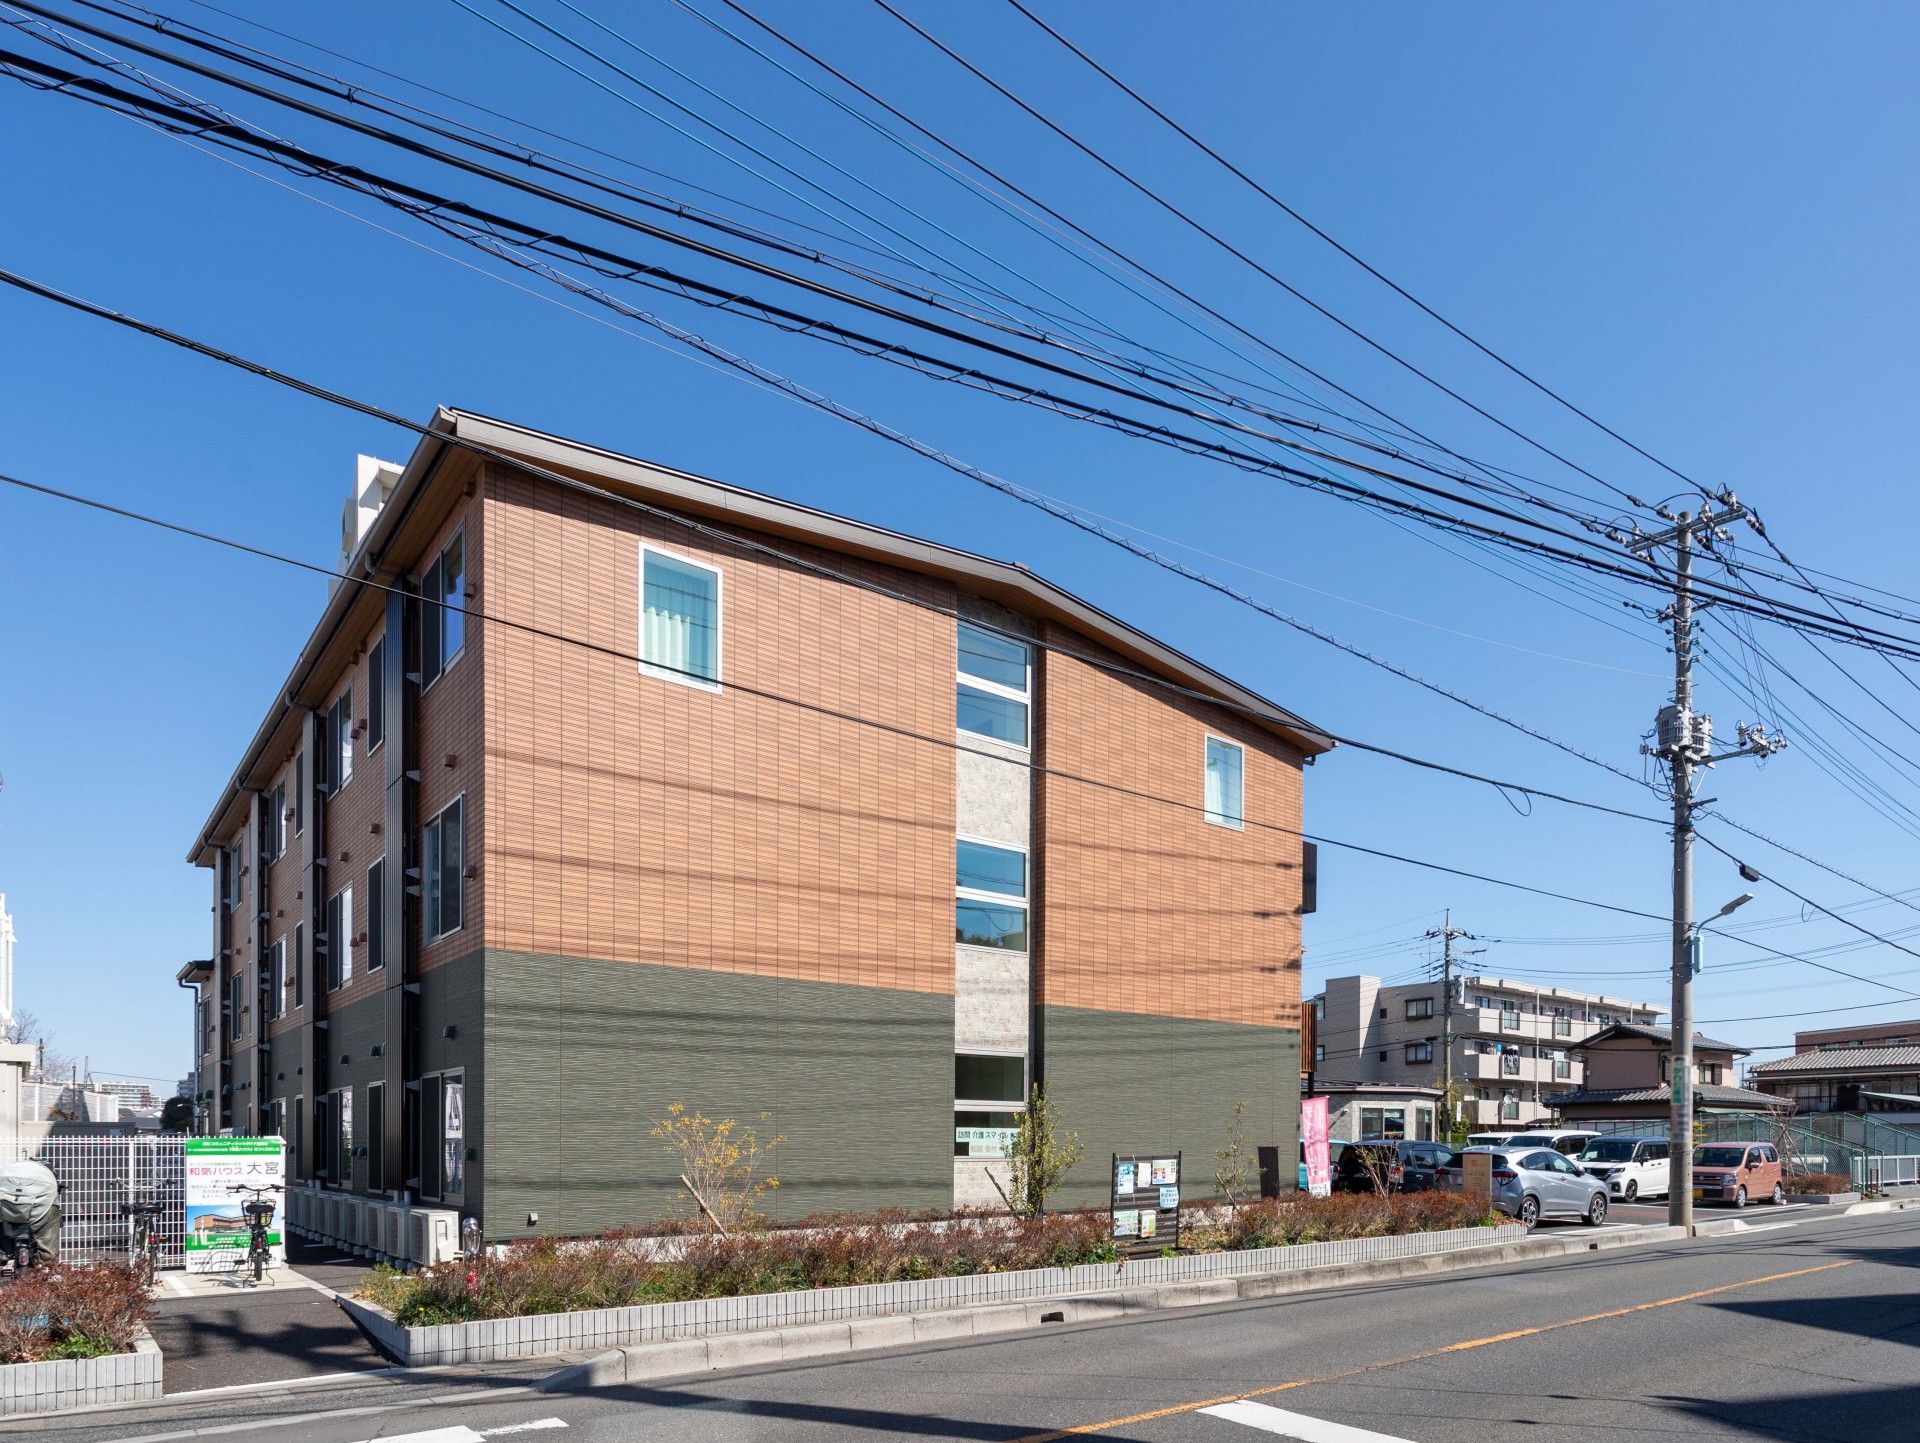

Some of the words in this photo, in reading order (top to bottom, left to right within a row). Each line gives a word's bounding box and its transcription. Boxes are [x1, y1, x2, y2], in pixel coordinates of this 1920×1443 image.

[189, 1167, 243, 1176] 和気ハウス
[247, 1161, 279, 1175] 大宮
